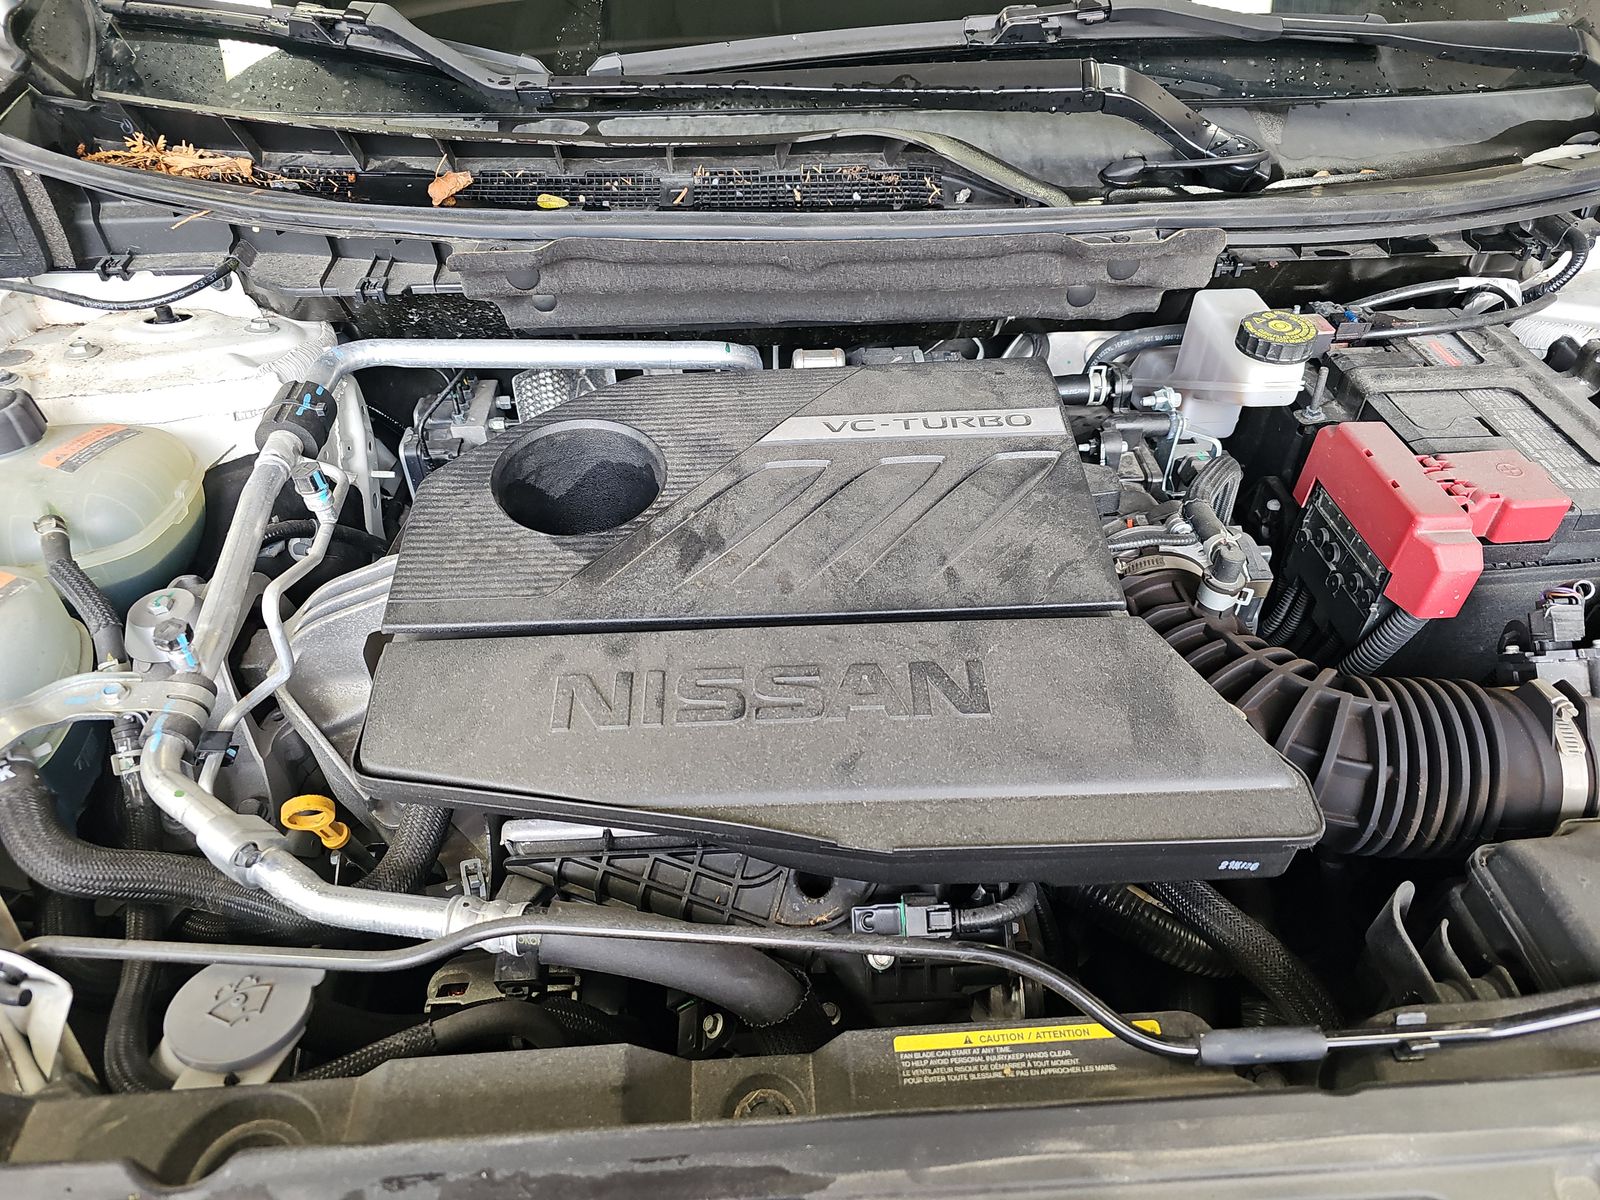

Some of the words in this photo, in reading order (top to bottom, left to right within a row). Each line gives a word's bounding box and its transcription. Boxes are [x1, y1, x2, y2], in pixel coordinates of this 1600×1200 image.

[822, 413, 1032, 433] VC-TURBO
[550, 660, 992, 733] NISSAN
[979, 1032, 1024, 1044] CAUTION
[1035, 1028, 1090, 1039] ATTENTION
[914, 1051, 936, 1059] BLADE
[929, 1058, 950, 1066] AVOID
[950, 1057, 985, 1065] PERSONAL
[1025, 1051, 1049, 1059] HANDS
[903, 1077, 923, 1085] POUR
[923, 1075, 946, 1083] ÉVITER
[947, 1073, 968, 1081] TOUTE
[1016, 1069, 1029, 1077] PAS
[1040, 1066, 1081, 1076] APPROCHER
[1082, 1065, 1094, 1073] LES
[911, 1067, 953, 1076] VENTILATEUR
[954, 1065, 979, 1073] RISQUE
[1033, 1059, 1049, 1067] TOUT
